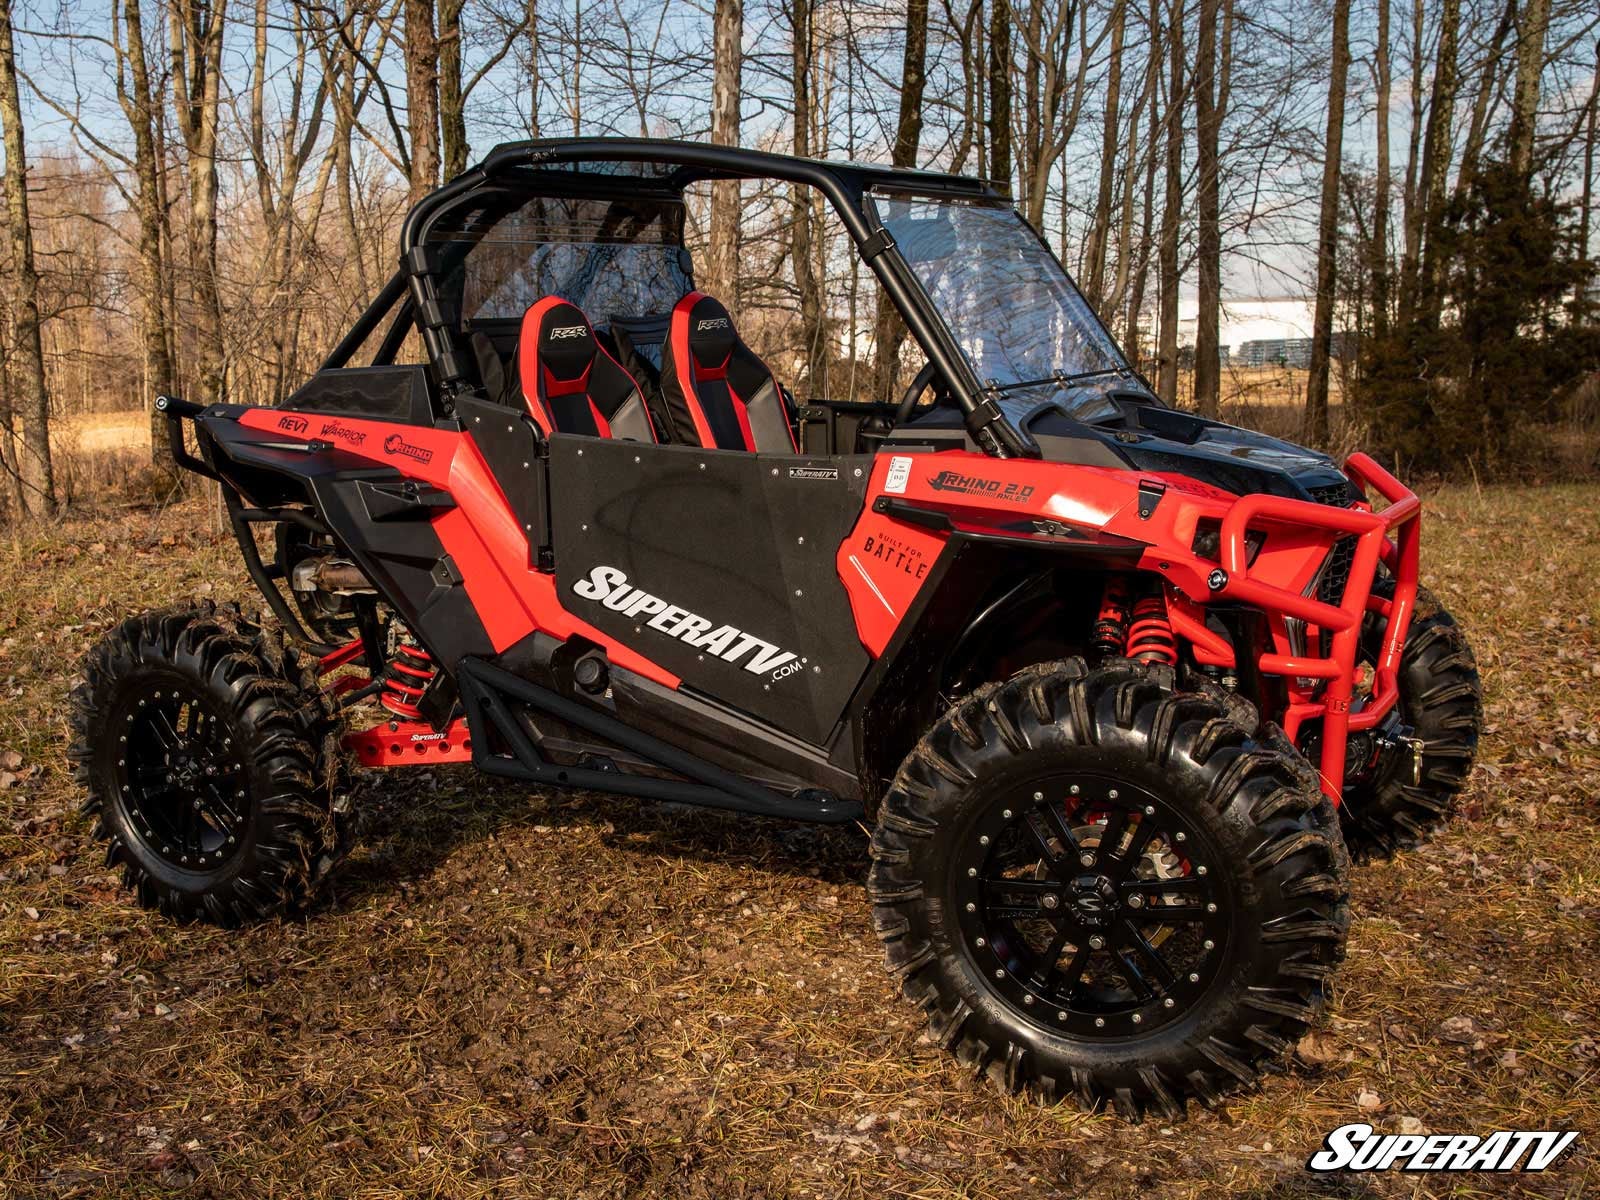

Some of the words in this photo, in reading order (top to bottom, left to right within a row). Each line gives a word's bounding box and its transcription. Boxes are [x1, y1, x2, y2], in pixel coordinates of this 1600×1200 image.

[550, 325, 588, 340] RZR
[698, 318, 729, 331] RZR
[320, 423, 367, 446] WARRIOR
[396, 443, 432, 461] RHINO
[943, 473, 1001, 492] RHINO
[1004, 483, 1034, 497] 2.0
[996, 493, 1029, 503] AXLES
[879, 532, 902, 548] BUILT
[905, 546, 922, 558] FOR
[864, 536, 927, 579] BATTLE
[573, 565, 798, 675] SUPERATV
